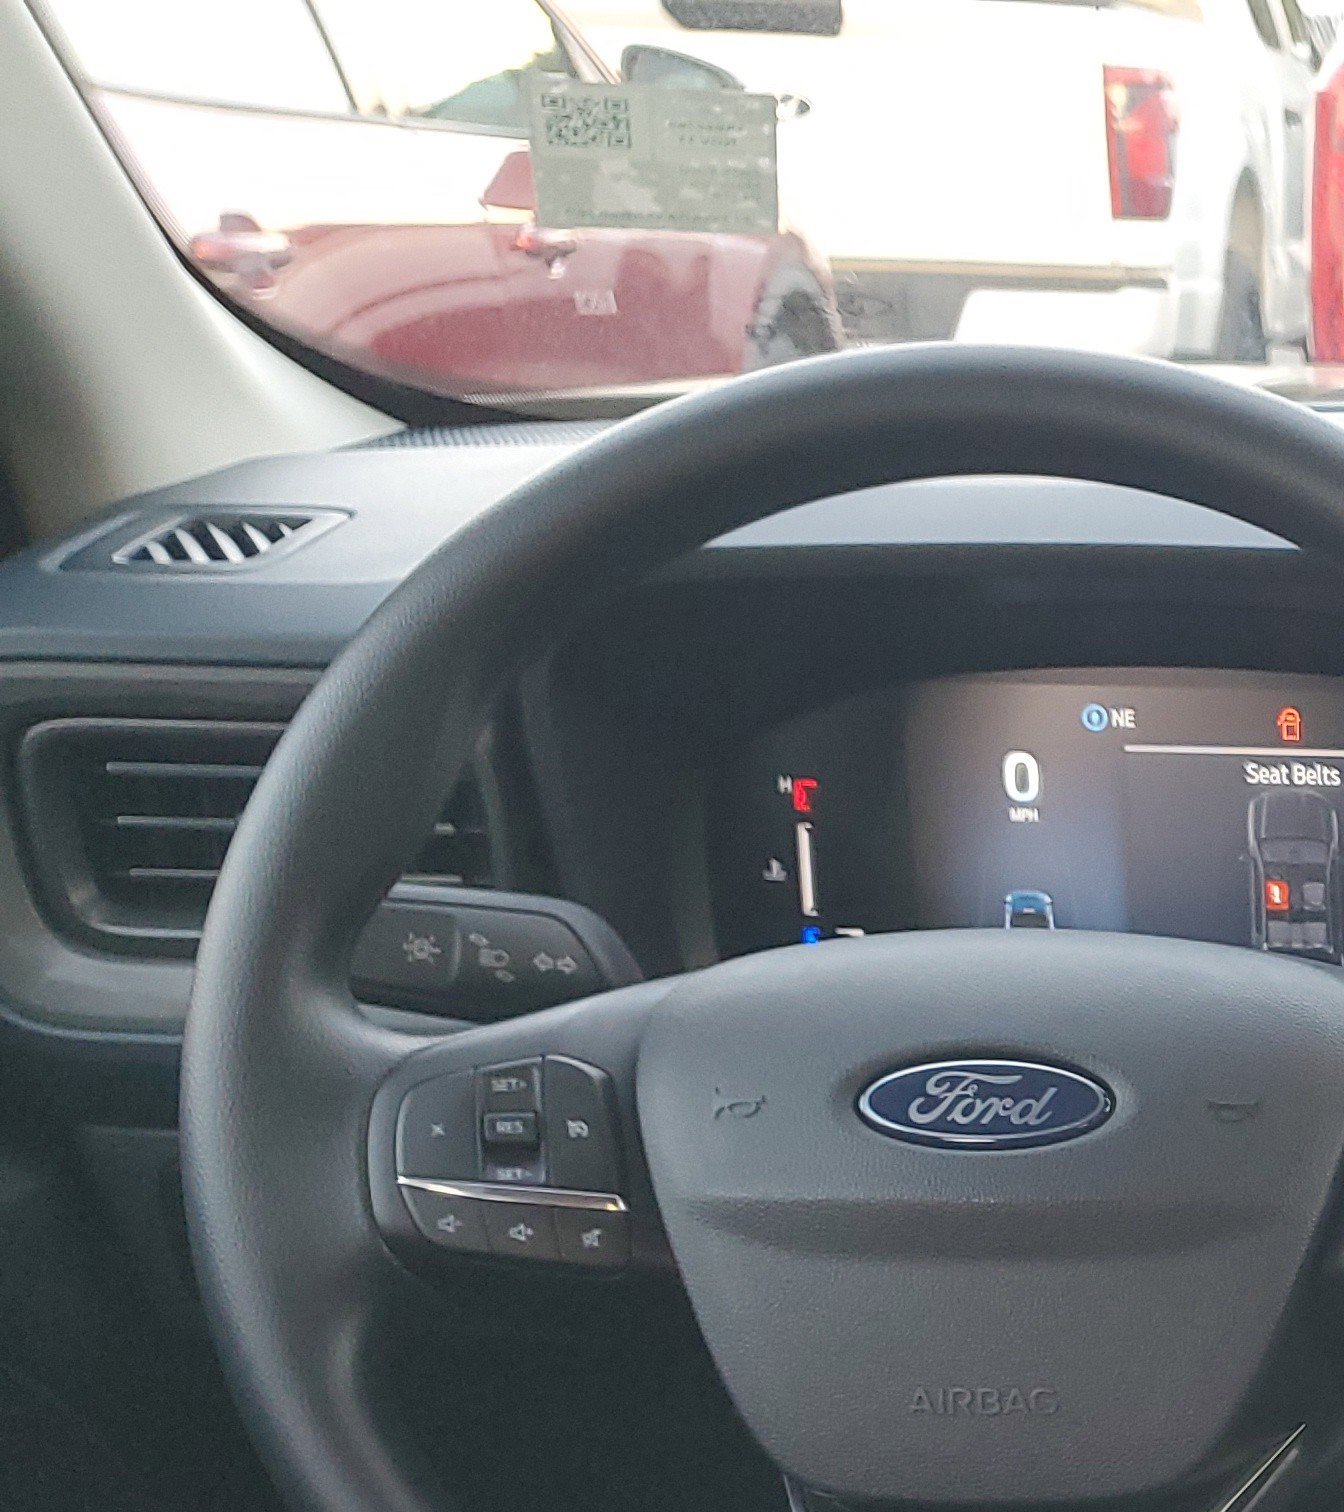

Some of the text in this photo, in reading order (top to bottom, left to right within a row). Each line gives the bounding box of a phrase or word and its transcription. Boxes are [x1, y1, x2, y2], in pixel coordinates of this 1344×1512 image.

[1111, 707, 1137, 728] NE
[1004, 751, 1040, 802] 0
[1245, 762, 1341, 787] Seat Belts
[908, 1071, 1058, 1126] Ford
[910, 1385, 1061, 1416] AIRBAG
